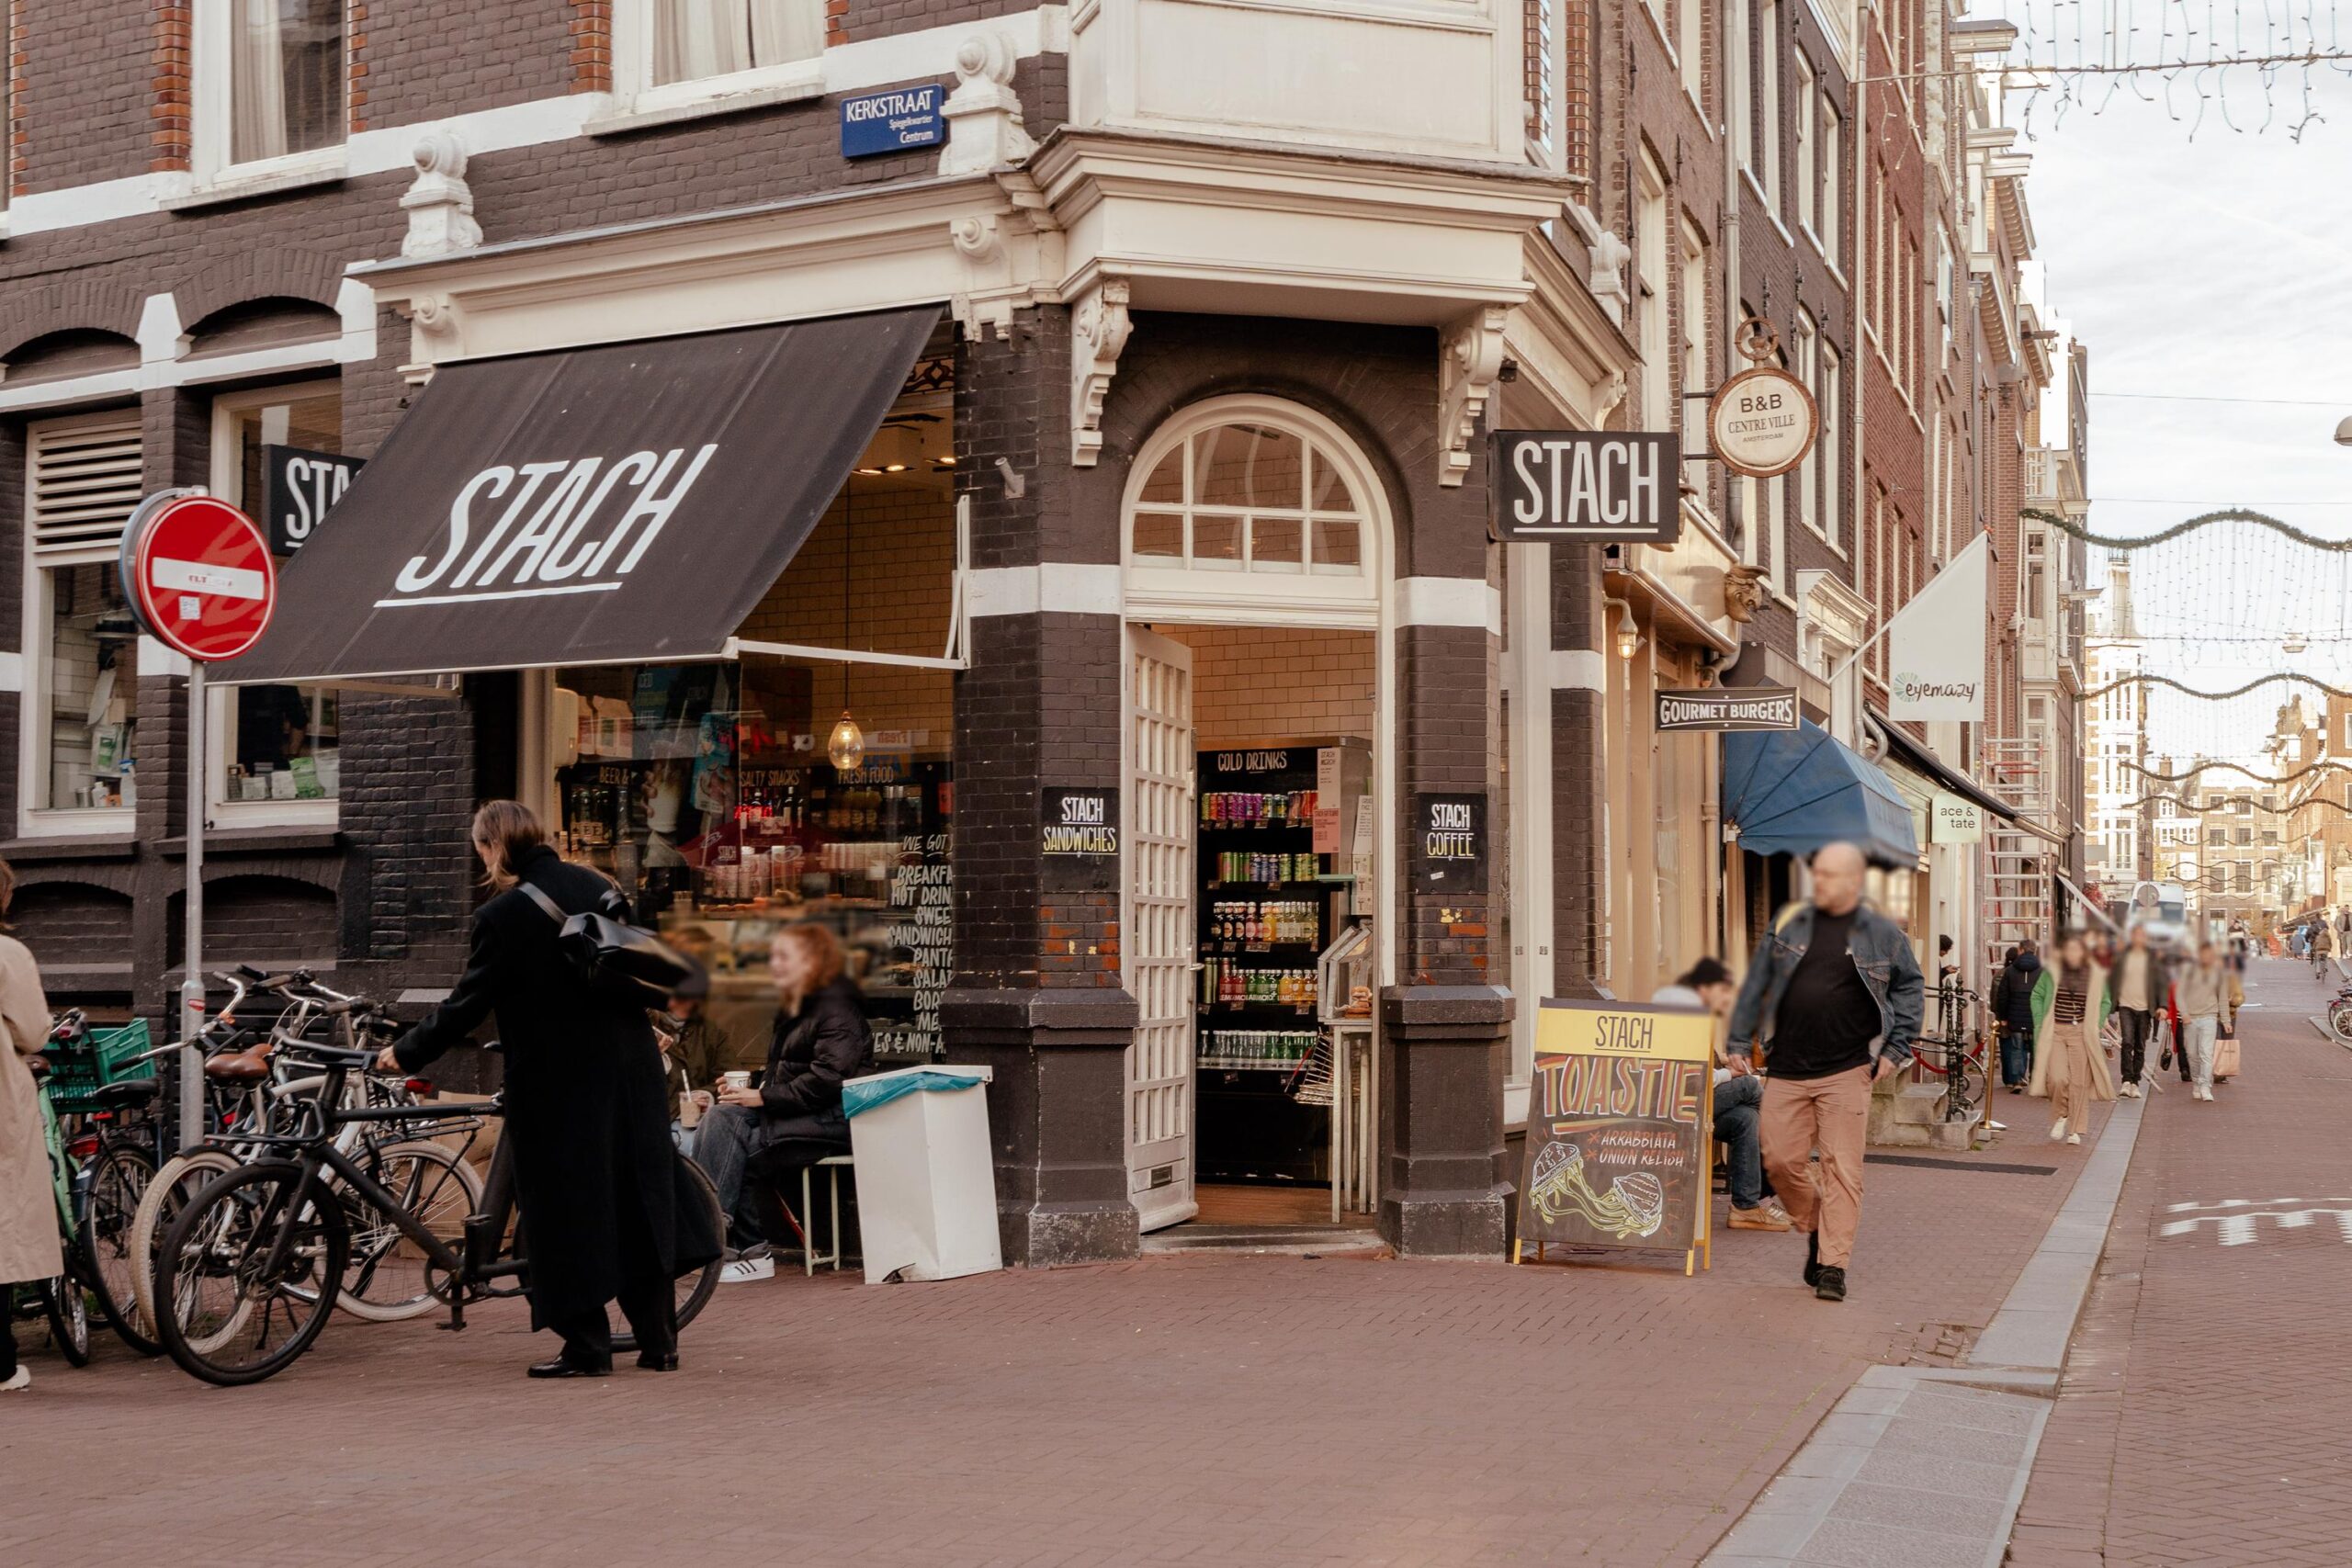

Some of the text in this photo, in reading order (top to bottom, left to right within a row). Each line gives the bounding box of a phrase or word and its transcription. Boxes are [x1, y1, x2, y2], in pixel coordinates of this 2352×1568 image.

[846, 90, 933, 122] KERKSTRAAT
[899, 131, 933, 143] Centrum
[1740, 393, 1781, 412] B&B
[1728, 413, 1795, 434] CENTRE VILLE
[1743, 433, 1784, 442] AMSTERDAM
[1513, 440, 1658, 524] STACH
[286, 457, 361, 539] STA
[394, 444, 718, 592] STACH
[1905, 683, 1975, 703] eyemazy
[1660, 699, 1793, 724] GOURMET BURGERS
[1217, 750, 1287, 772] COLD DRINKS
[741, 769, 800, 787] SALTY SNACKS
[838, 766, 894, 784] FRESH FOOD
[1061, 796, 1103, 822] STACH
[1431, 804, 1470, 829] STACH
[1940, 807, 1974, 817] ace &
[1951, 818, 1975, 829] tate
[902, 836, 922, 851] WE
[926, 834, 948, 851] GOT
[1043, 827, 1116, 852] SANDWICHES
[1427, 832, 1475, 856] COFFEE
[891, 886, 953, 906] HOT DRIN
[915, 906, 953, 925] SWEE
[888, 926, 952, 948] SANDWICH
[913, 990, 944, 1010] BOR
[917, 1011, 942, 1032] ME
[872, 1032, 946, 1054] ES & NON-A
[1595, 1016, 1654, 1049] STACH
[1534, 1056, 1703, 1123] TOASTIE
[1601, 1131, 1677, 1148] ARRABBIATA
[1600, 1149, 1685, 1167] ONION RELISH
